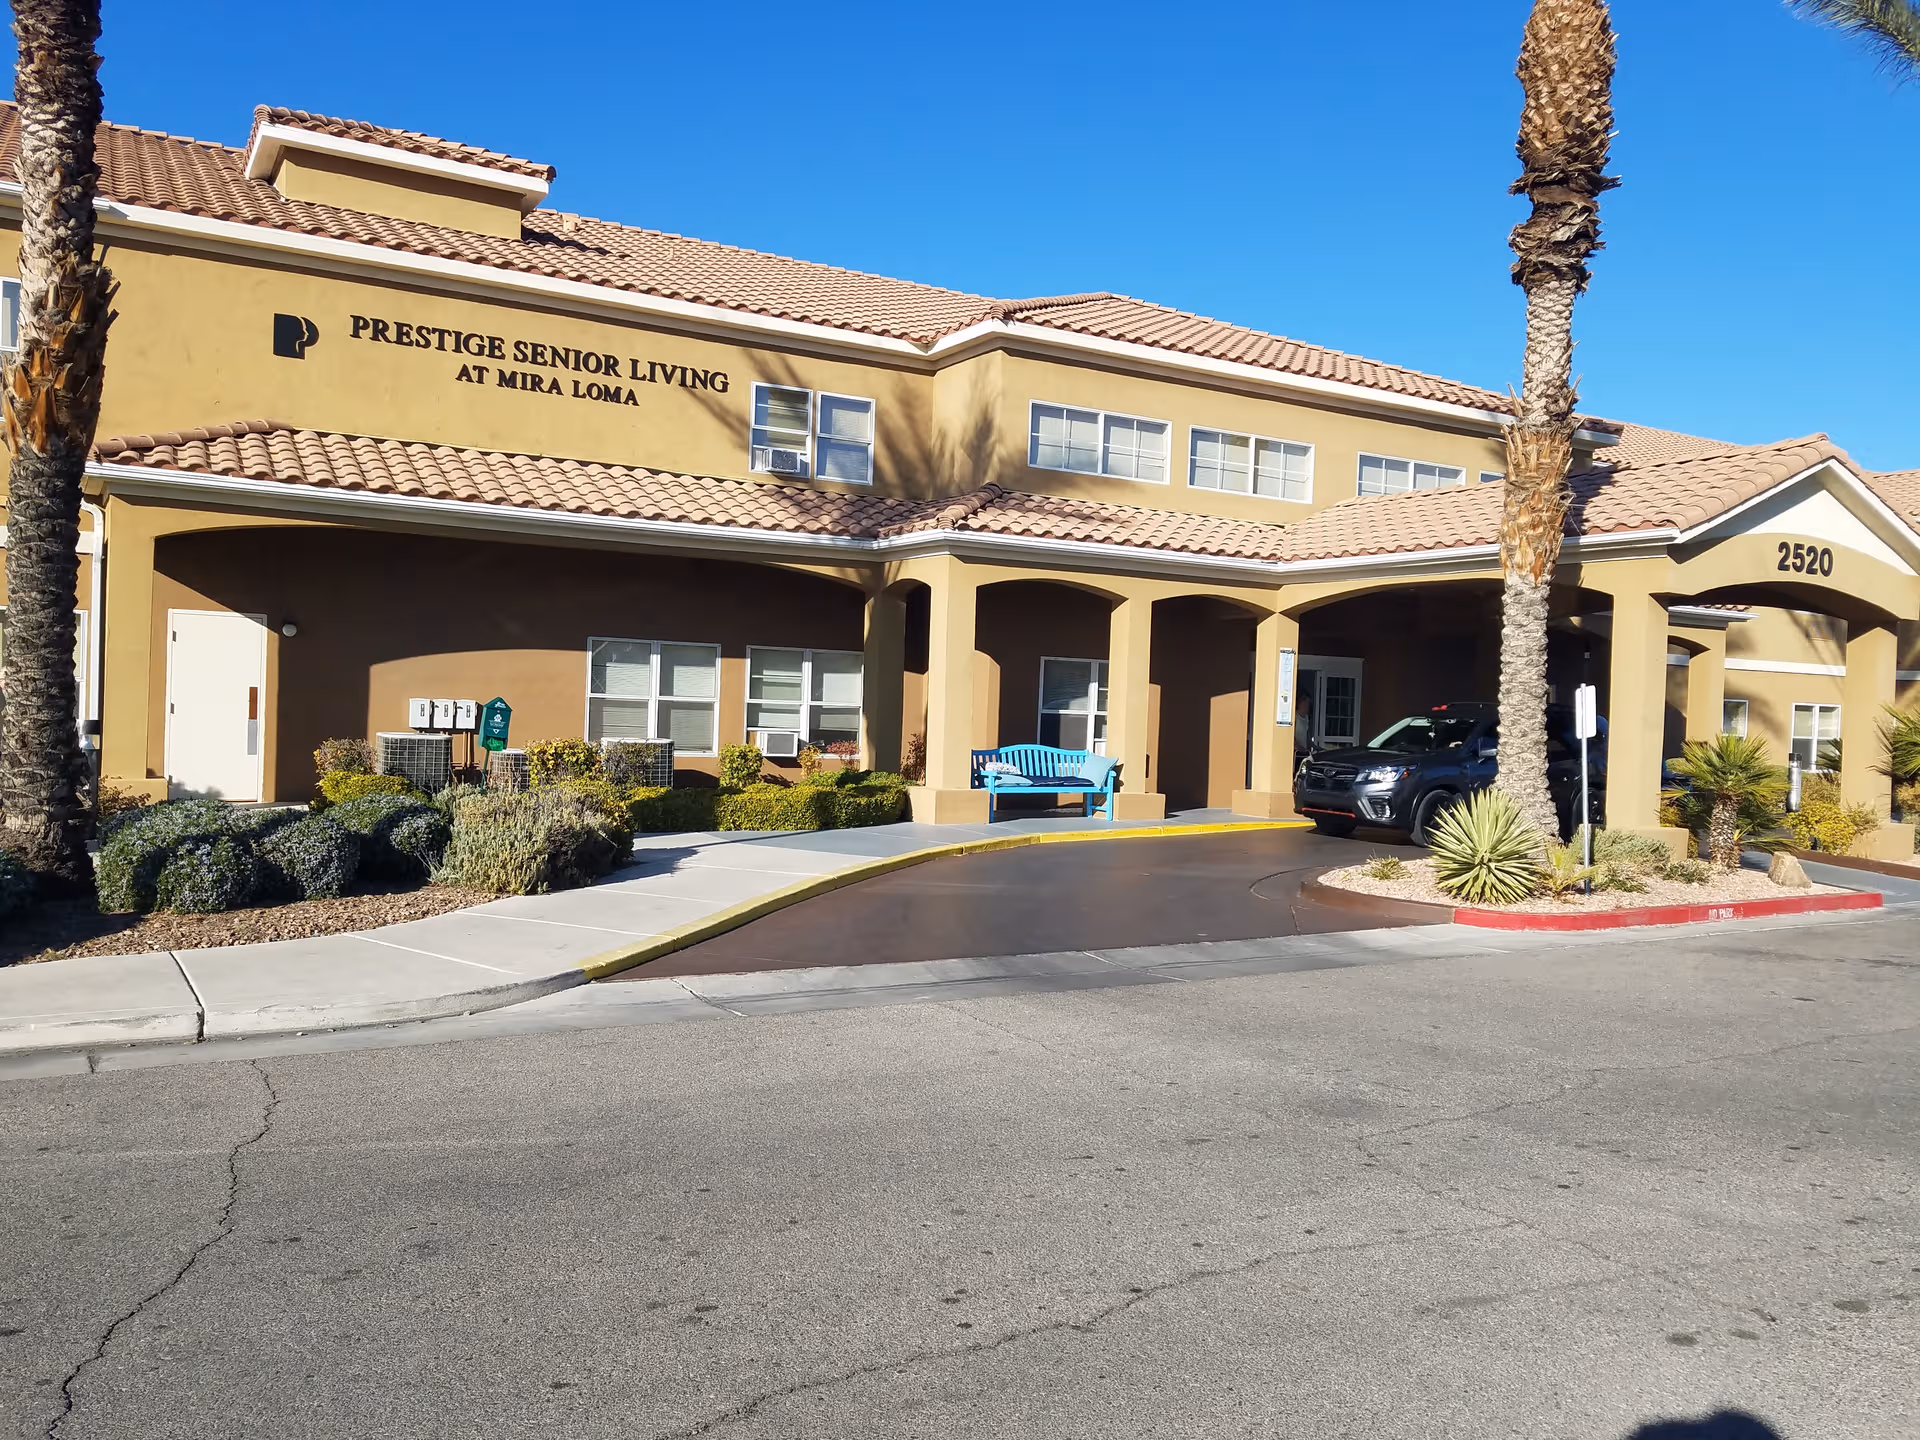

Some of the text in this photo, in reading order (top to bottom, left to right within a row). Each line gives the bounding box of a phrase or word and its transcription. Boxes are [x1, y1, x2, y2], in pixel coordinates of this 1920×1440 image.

[349, 314, 729, 393] PRESTIGE SENIOR LIVING
[455, 363, 640, 407] AT MIRA LOMA
[1777, 541, 1833, 577] 2520
